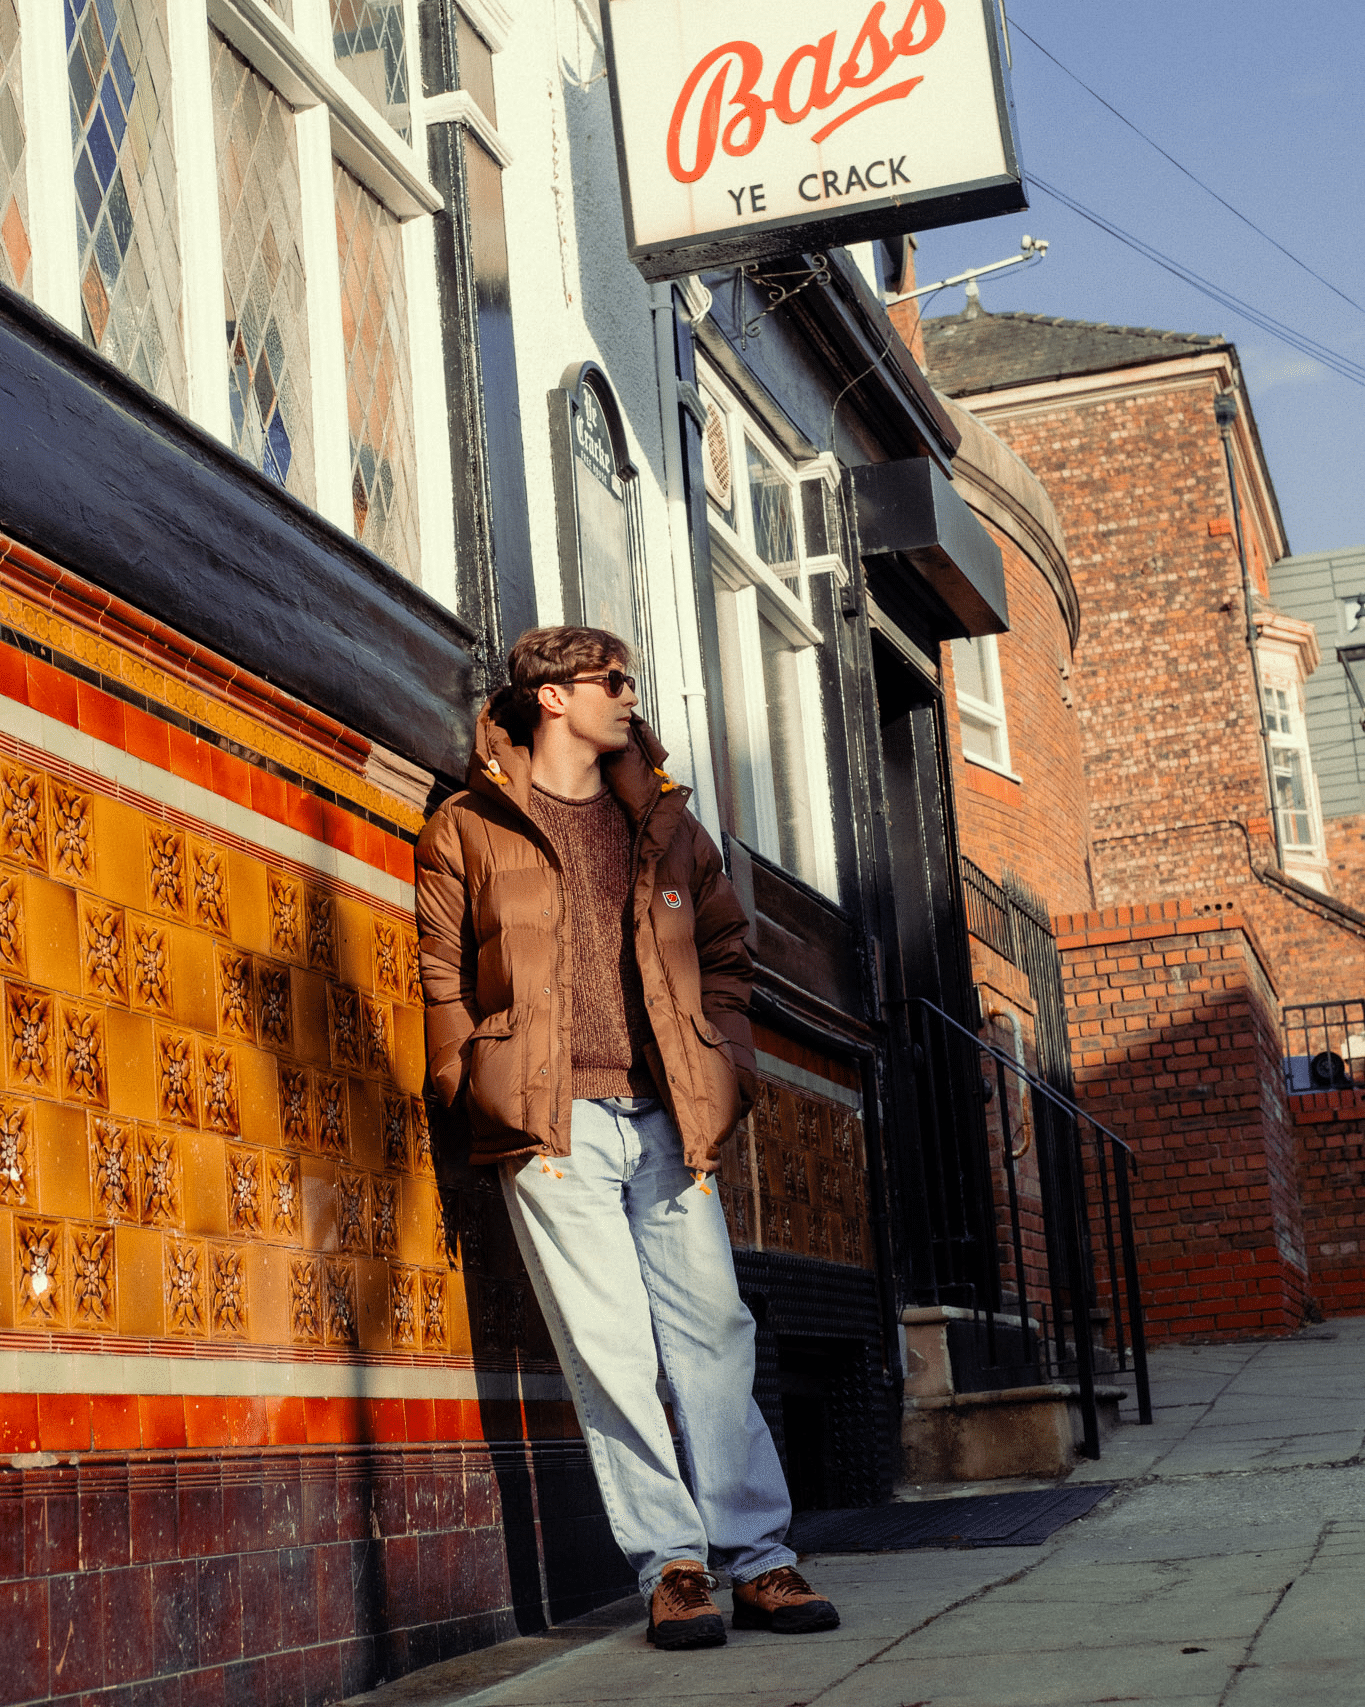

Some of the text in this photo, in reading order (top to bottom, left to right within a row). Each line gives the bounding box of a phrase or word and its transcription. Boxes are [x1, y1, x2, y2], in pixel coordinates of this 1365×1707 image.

[667, 0, 946, 183] Bass
[728, 155, 911, 216] YE CRACK
[583, 388, 598, 432] Ye
[576, 415, 610, 473] Cracke
